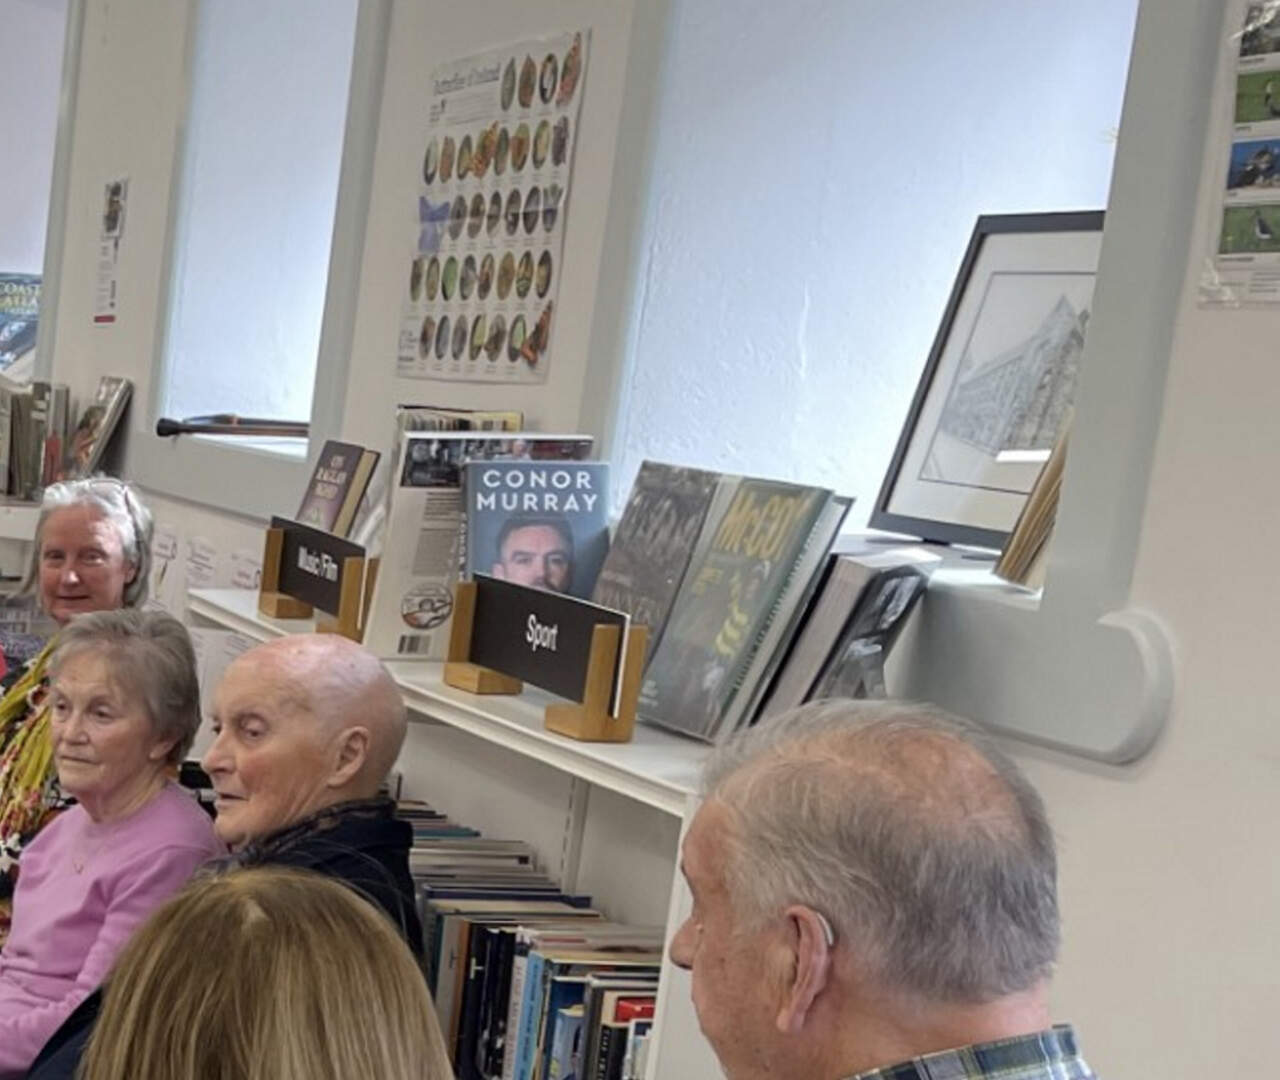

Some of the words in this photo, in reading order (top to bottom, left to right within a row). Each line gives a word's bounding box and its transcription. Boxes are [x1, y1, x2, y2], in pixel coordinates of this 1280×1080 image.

[483, 470, 591, 489] CONOR
[476, 492, 598, 512] MURRAY
[526, 613, 558, 652] Sport
